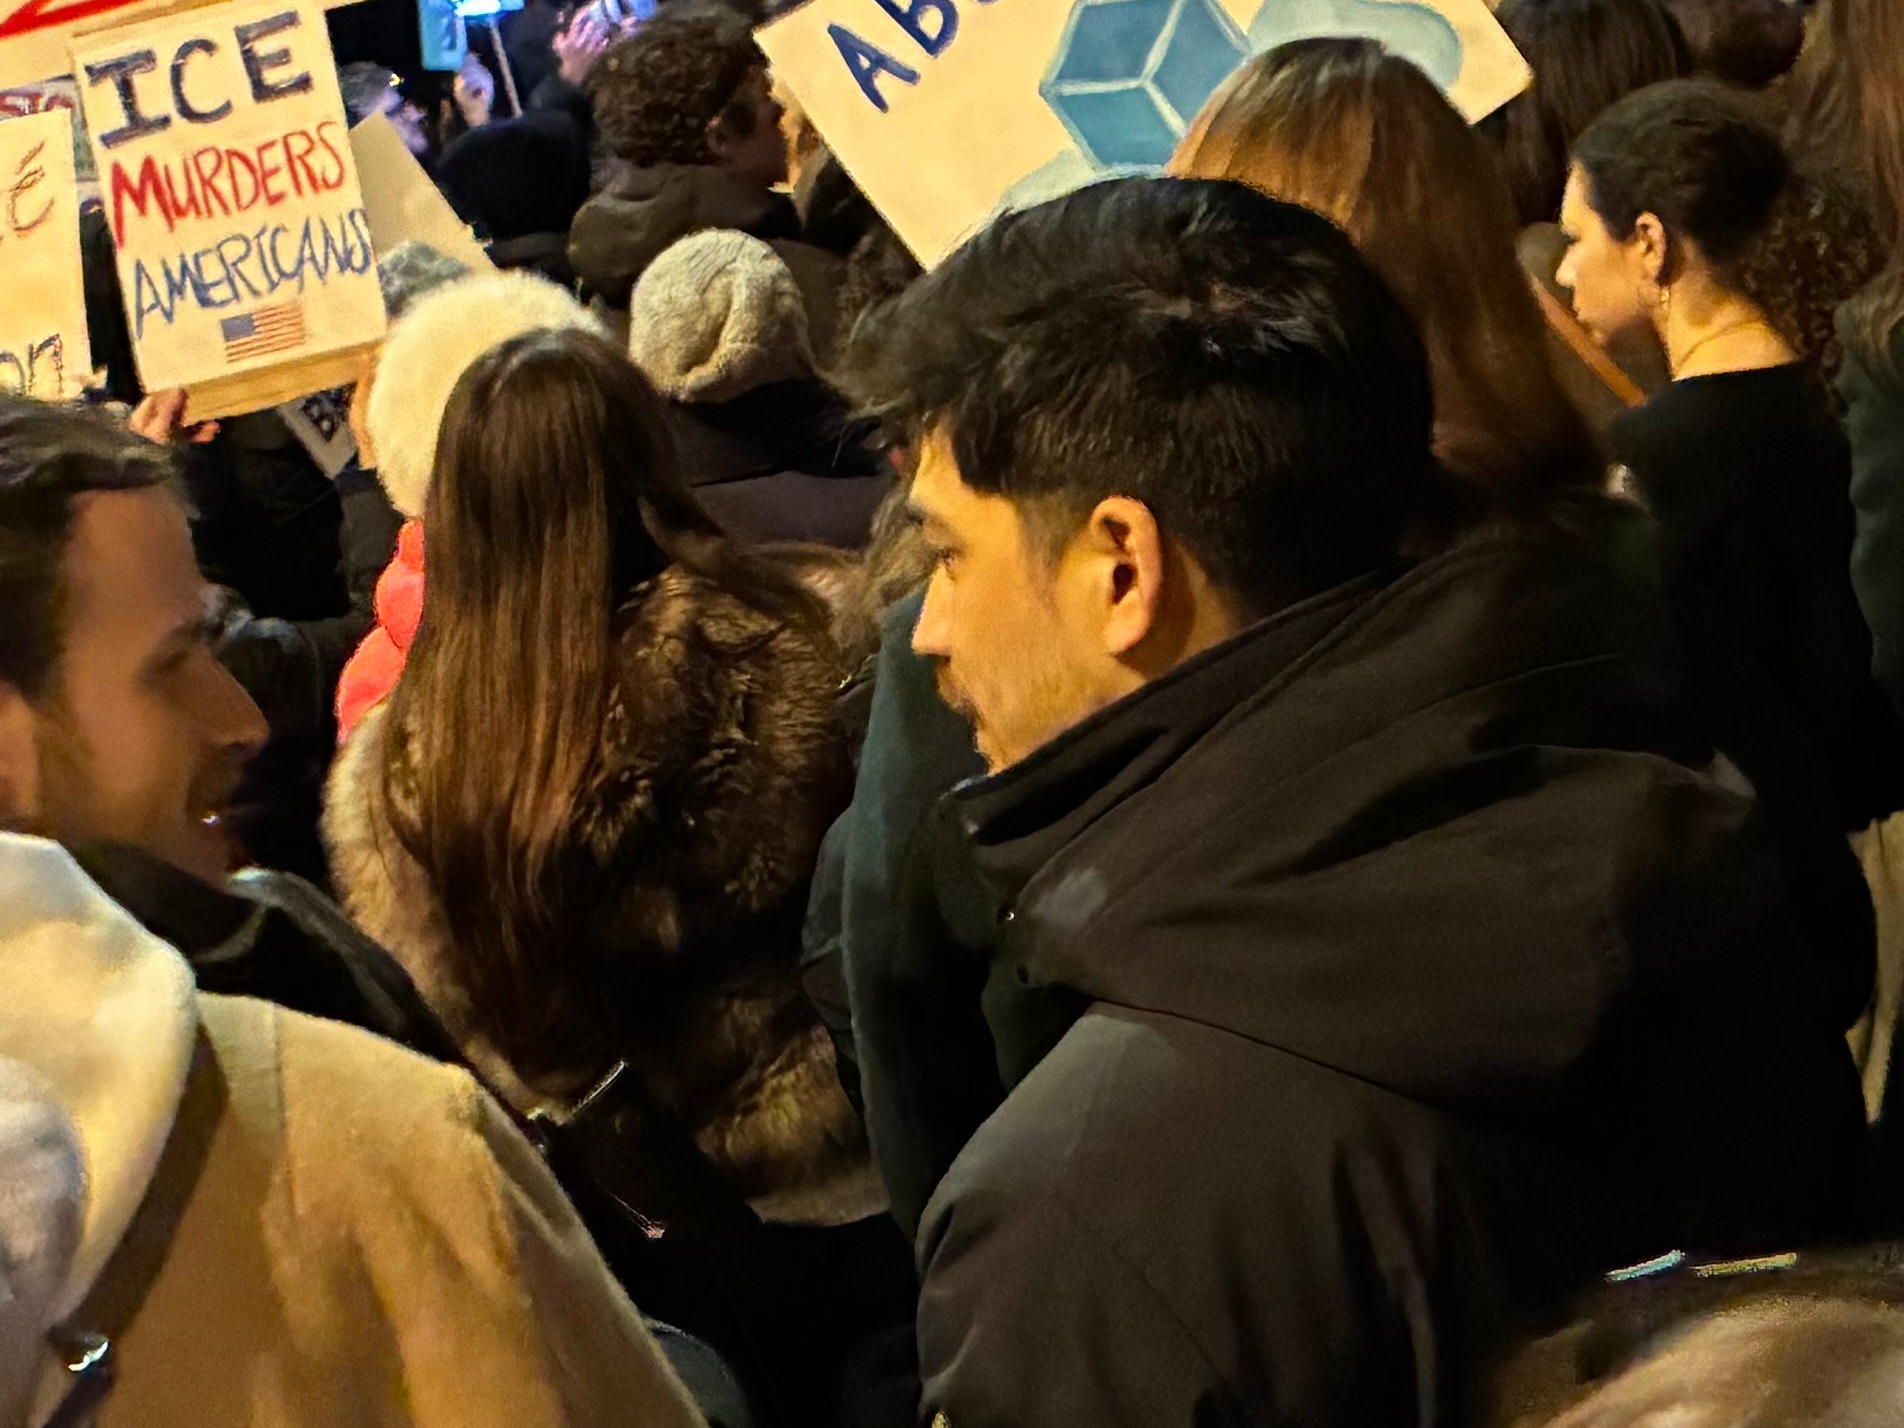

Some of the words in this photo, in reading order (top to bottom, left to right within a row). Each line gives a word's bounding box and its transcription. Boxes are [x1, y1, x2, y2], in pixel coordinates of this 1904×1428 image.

[84, 9, 316, 150] ICE
[109, 120, 346, 250] MURDERS
[133, 206, 374, 340] AMERICANS
